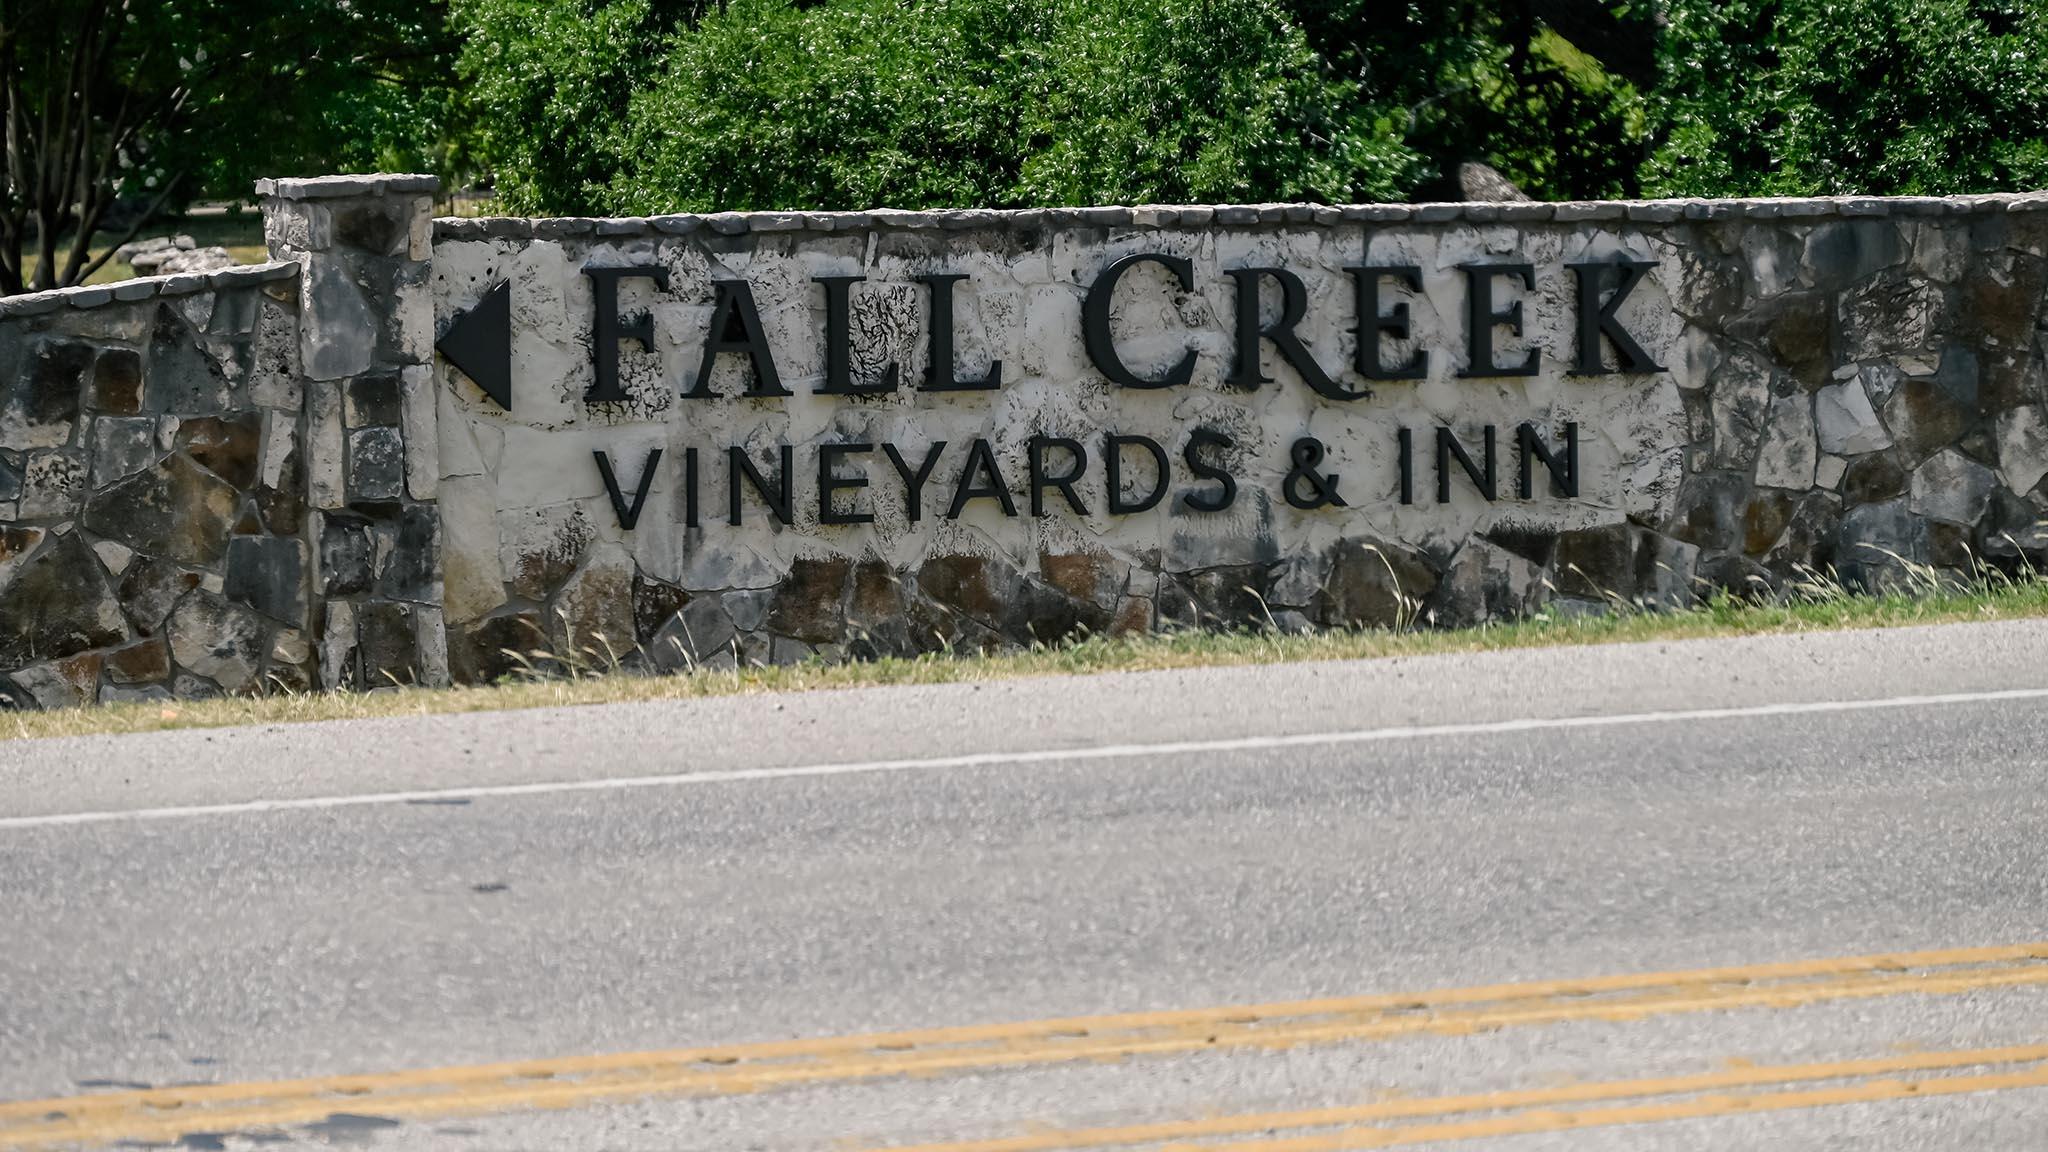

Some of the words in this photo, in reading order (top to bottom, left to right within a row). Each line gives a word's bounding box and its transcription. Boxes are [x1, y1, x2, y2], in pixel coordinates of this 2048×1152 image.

[582, 266, 1002, 402] FALL
[1082, 252, 1669, 400] CREEK
[593, 431, 1237, 531] VINEYARDS
[1283, 437, 1348, 509] &
[1399, 422, 1579, 505] INN
